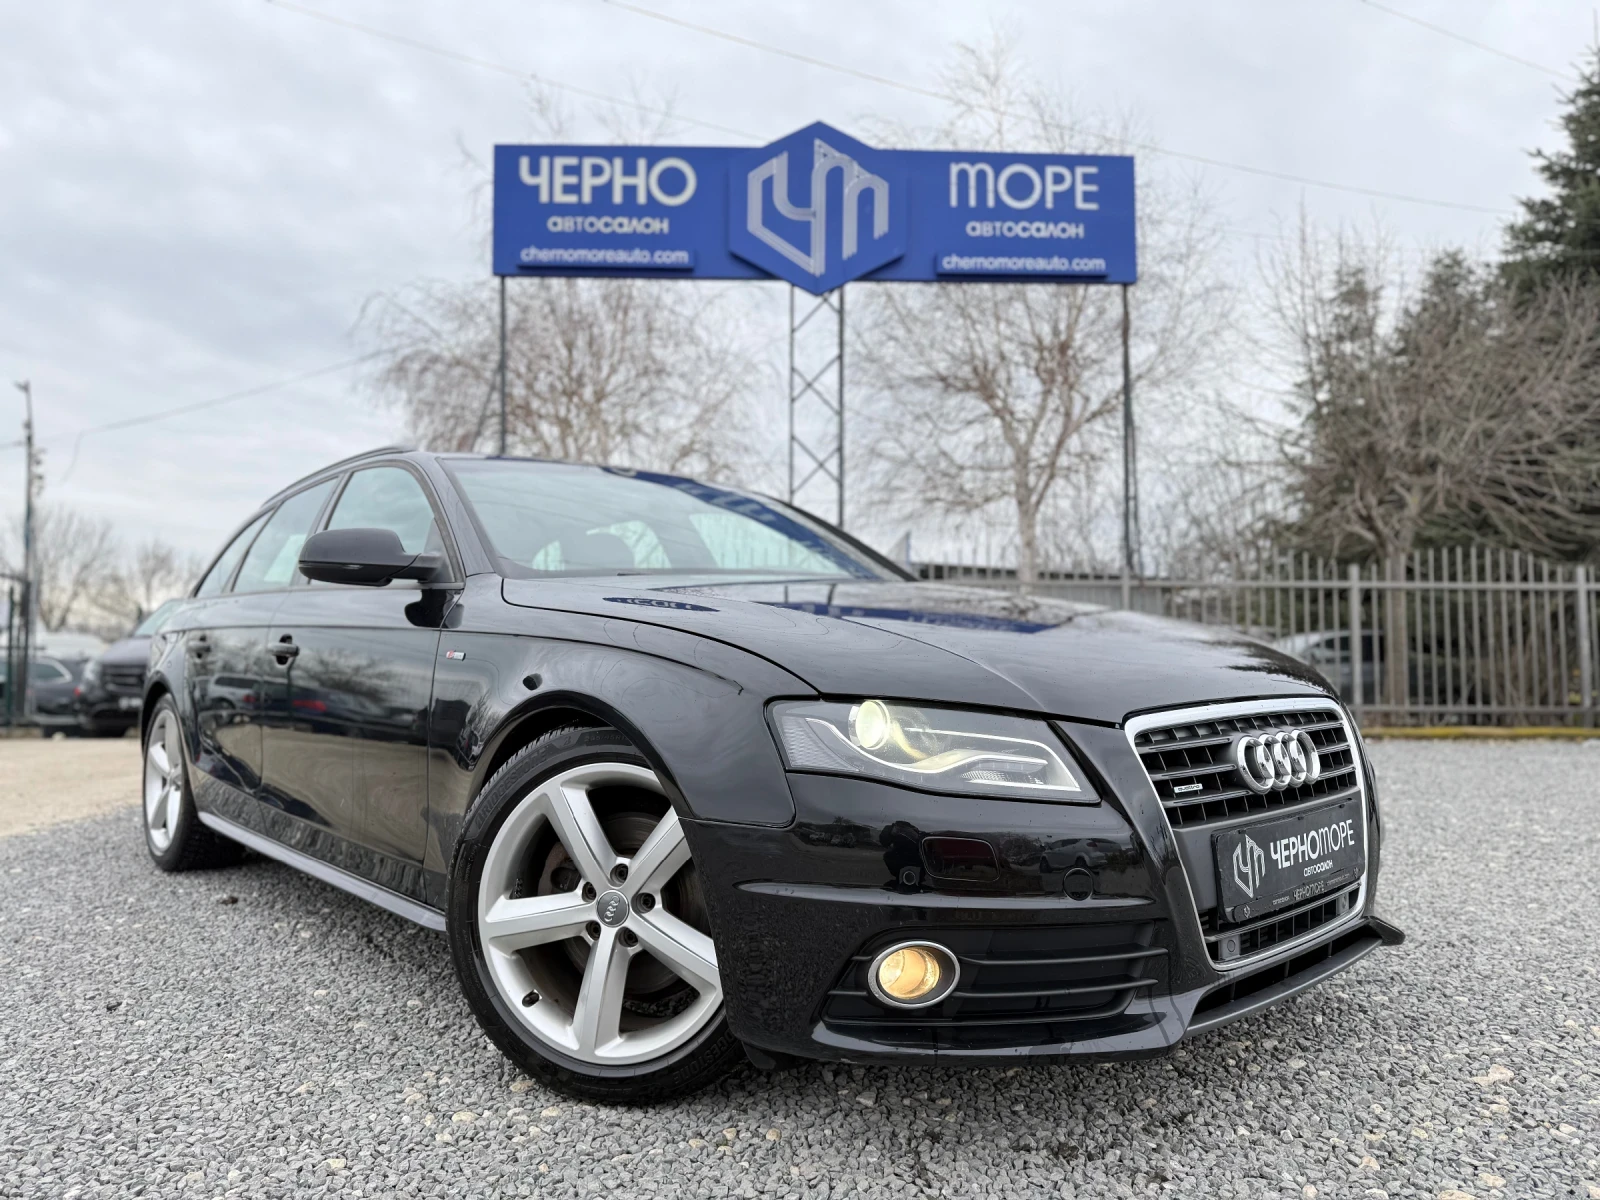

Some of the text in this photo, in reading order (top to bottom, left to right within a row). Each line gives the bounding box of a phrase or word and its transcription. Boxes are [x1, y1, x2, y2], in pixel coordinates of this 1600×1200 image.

[519, 155, 697, 207] ЧЕРНО
[520, 246, 689, 265] chernomoreauto.com
[942, 254, 1106, 271] chernomoreauto.com
